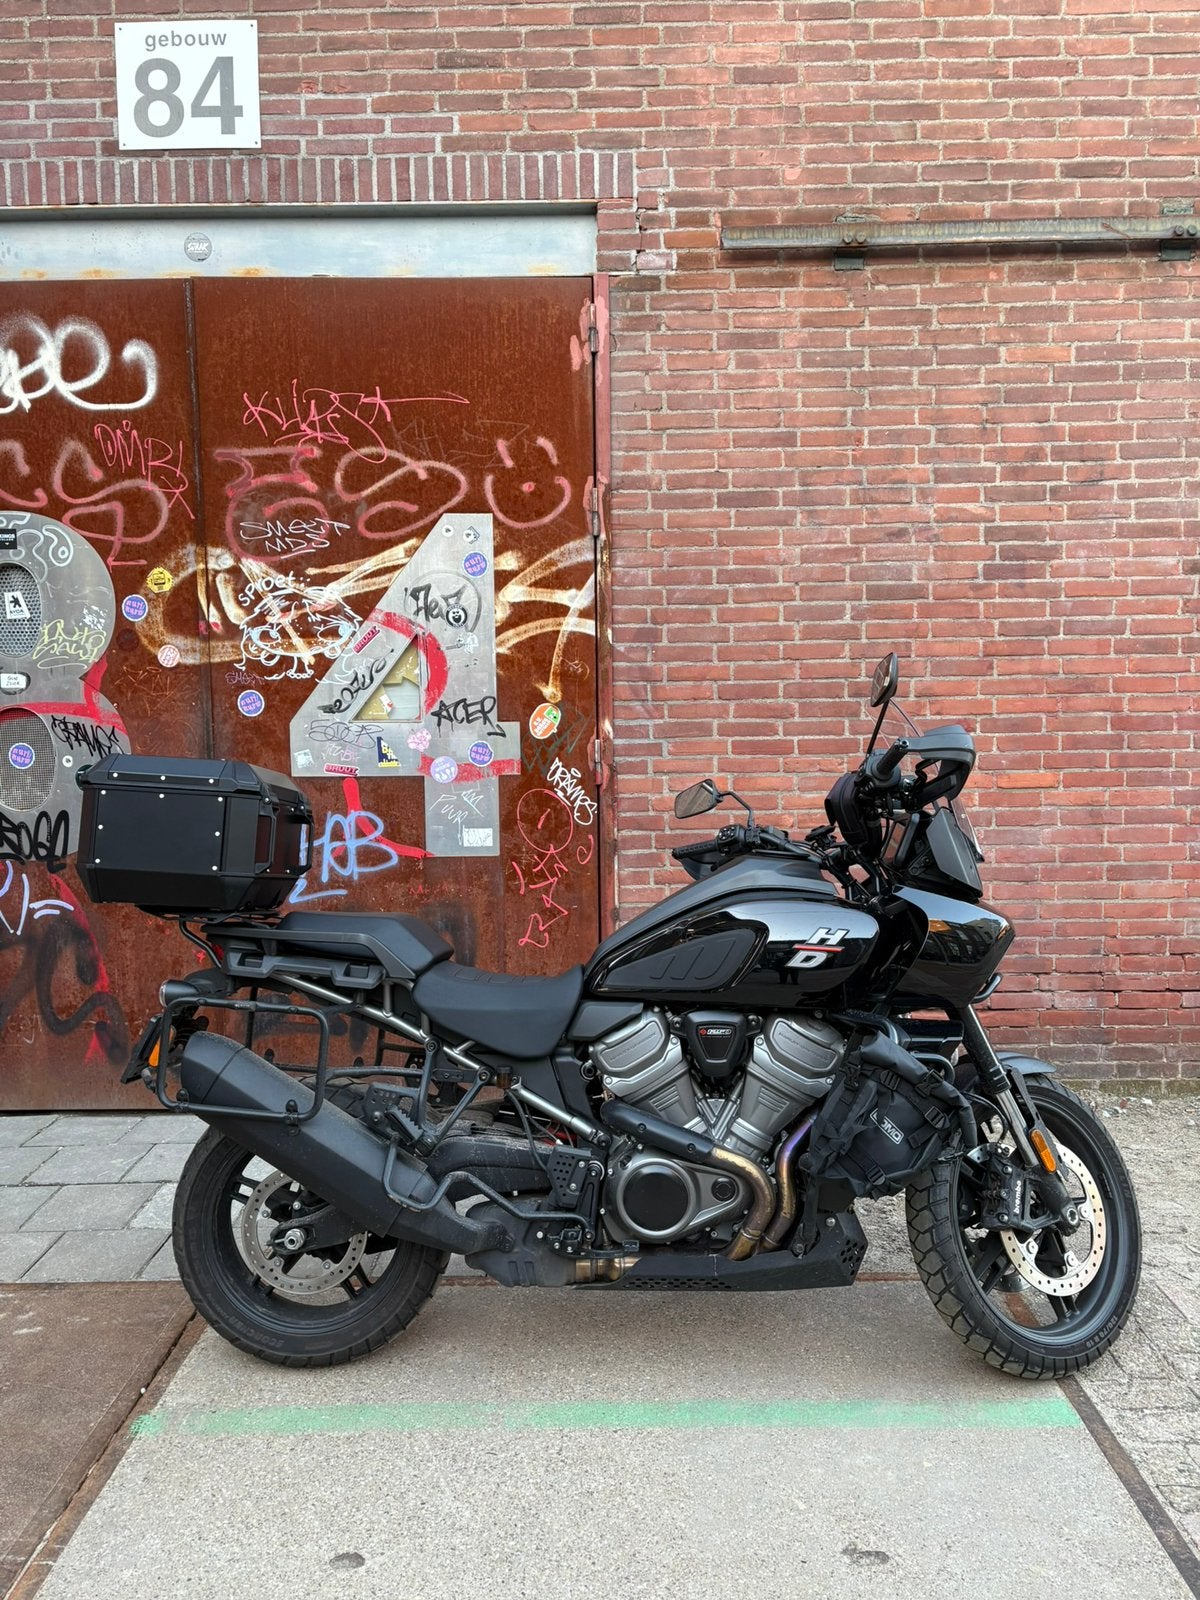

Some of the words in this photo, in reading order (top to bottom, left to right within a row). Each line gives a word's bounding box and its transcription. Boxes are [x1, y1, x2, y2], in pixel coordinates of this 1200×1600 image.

[145, 30, 227, 52] gebouw
[133, 56, 243, 138] 84
[265, 533, 330, 552] MDS
[1013, 1180, 1022, 1214] brembo
